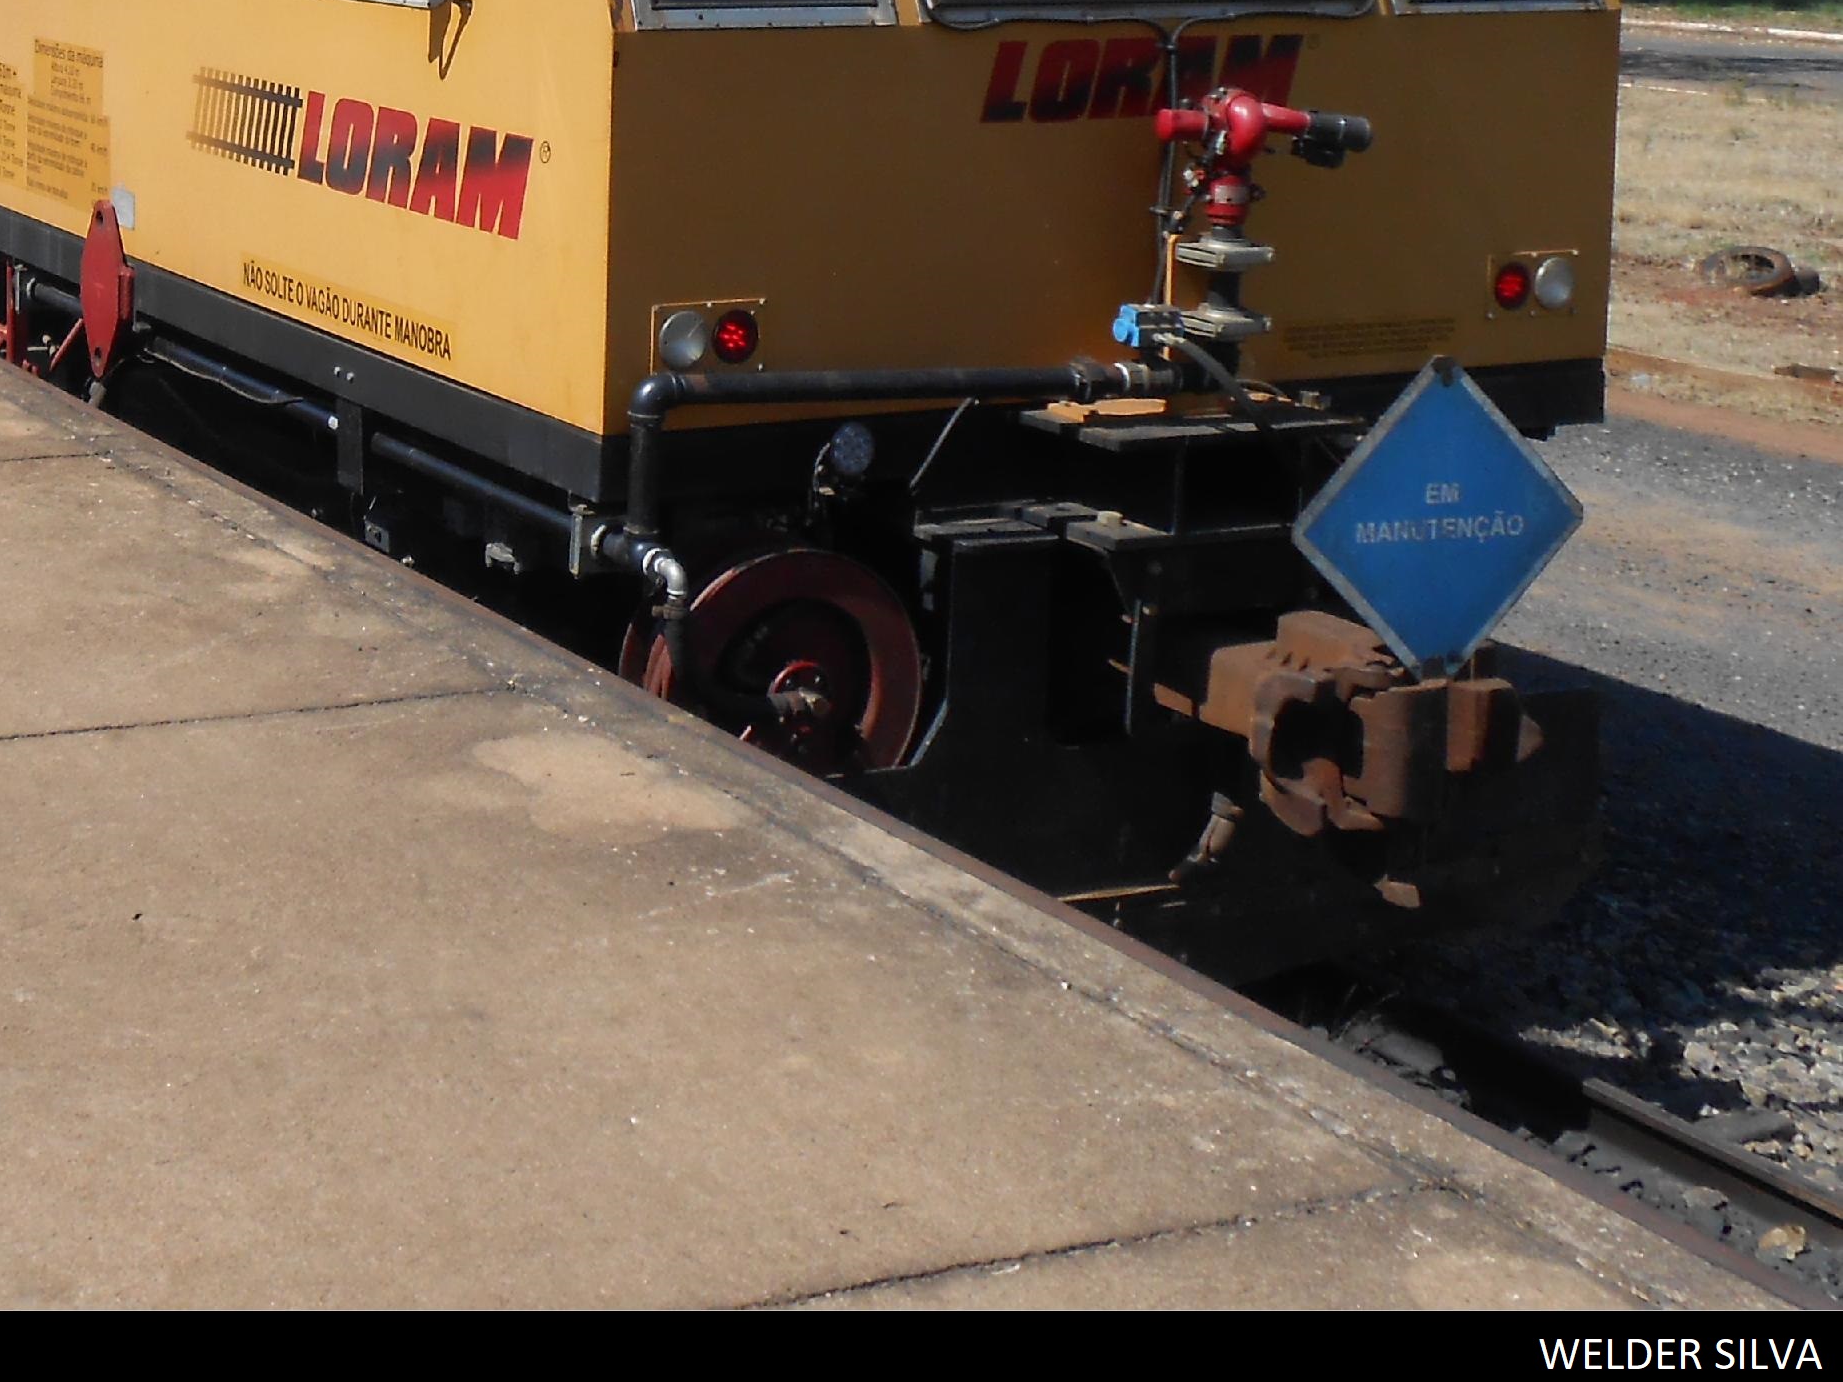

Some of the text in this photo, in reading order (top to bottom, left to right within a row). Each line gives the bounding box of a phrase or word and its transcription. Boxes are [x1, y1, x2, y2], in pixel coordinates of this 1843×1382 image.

[979, 34, 1304, 123] LORAM
[297, 90, 534, 240] LORAM
[243, 260, 452, 361] NÃO SOLTE O VAGÃO DURANTE MANOBRA
[1355, 509, 1525, 544] MANUTENÇÃO
[1424, 482, 1461, 505] EM
